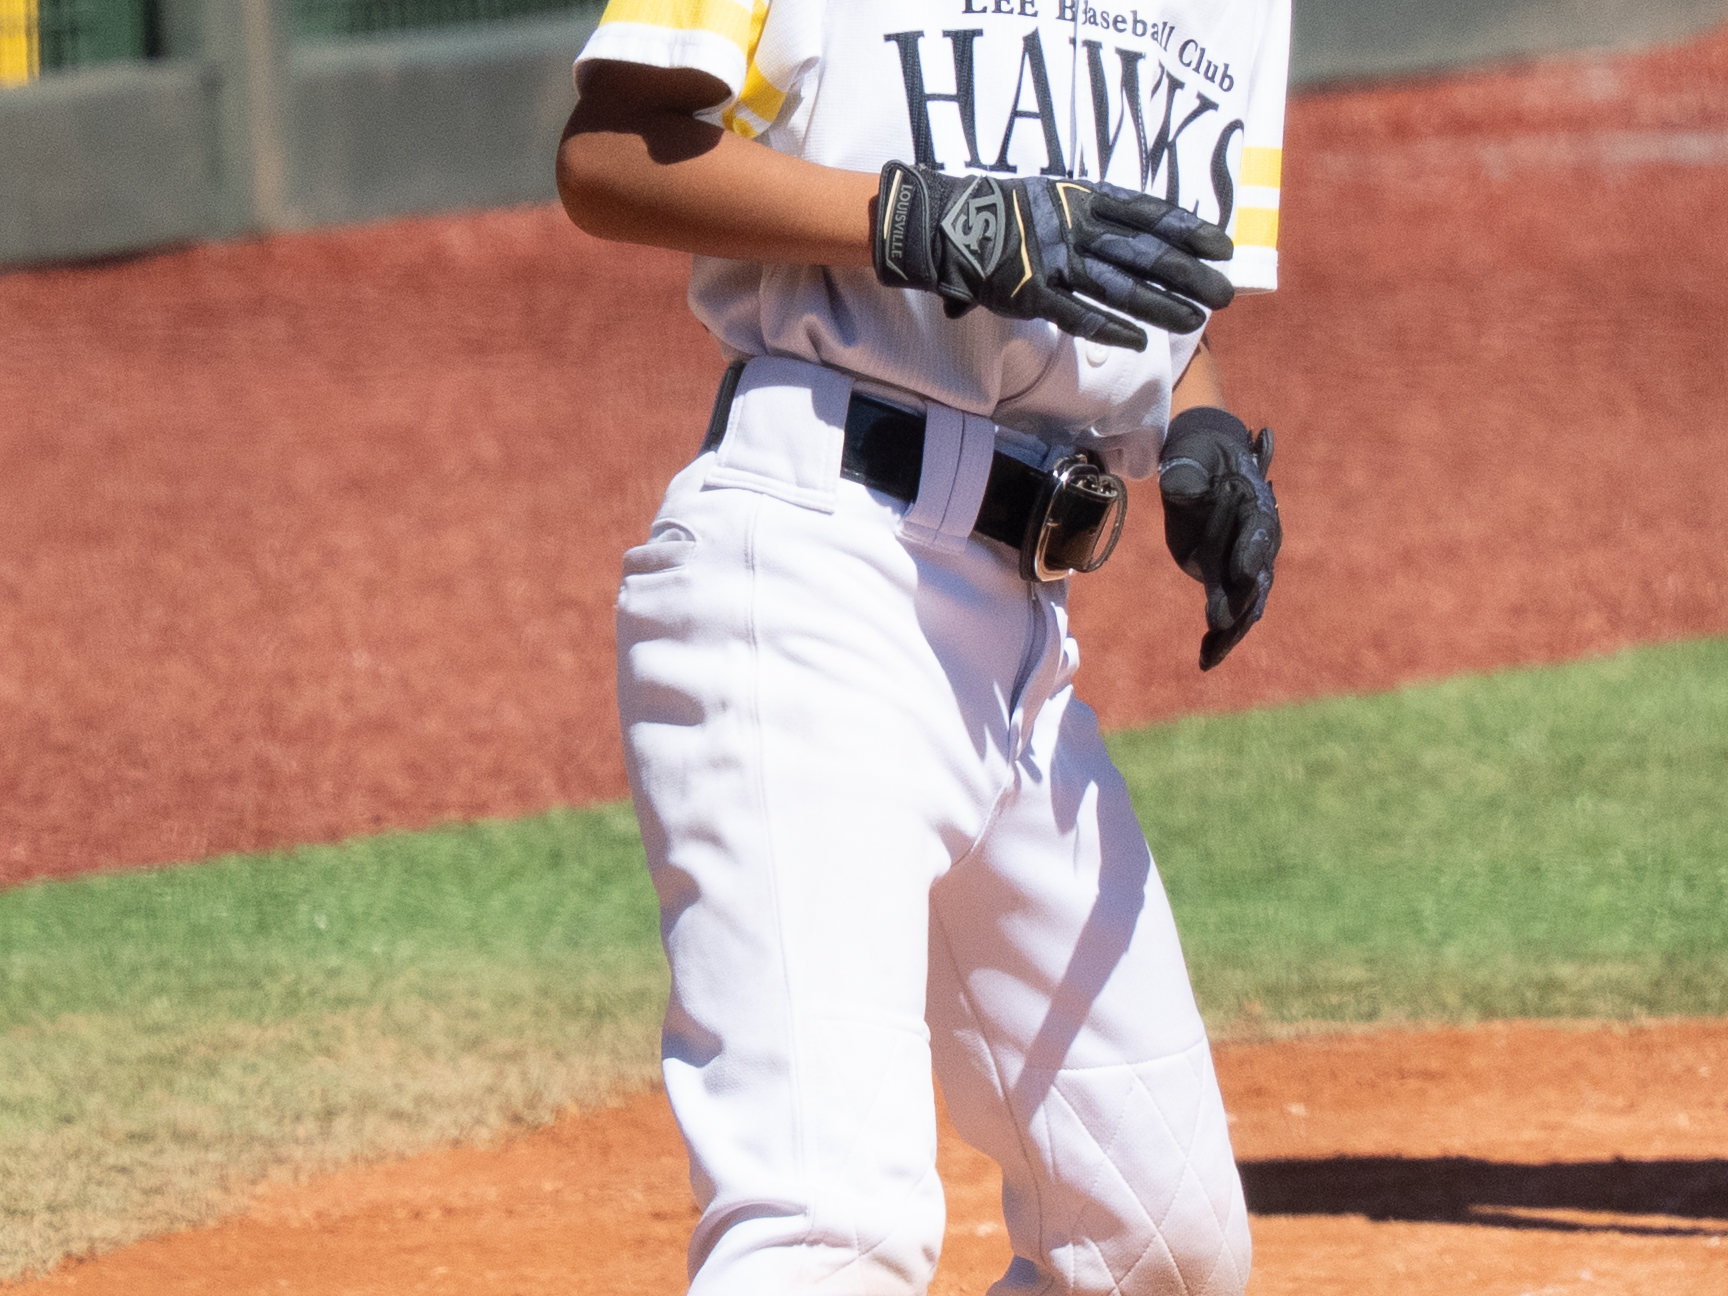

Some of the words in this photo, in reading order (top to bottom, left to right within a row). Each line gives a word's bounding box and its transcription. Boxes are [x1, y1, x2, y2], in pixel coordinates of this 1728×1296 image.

[1177, 39, 1235, 93] Club
[884, 26, 1246, 234] HAWKS
[891, 184, 913, 259] LOUISVILLE
